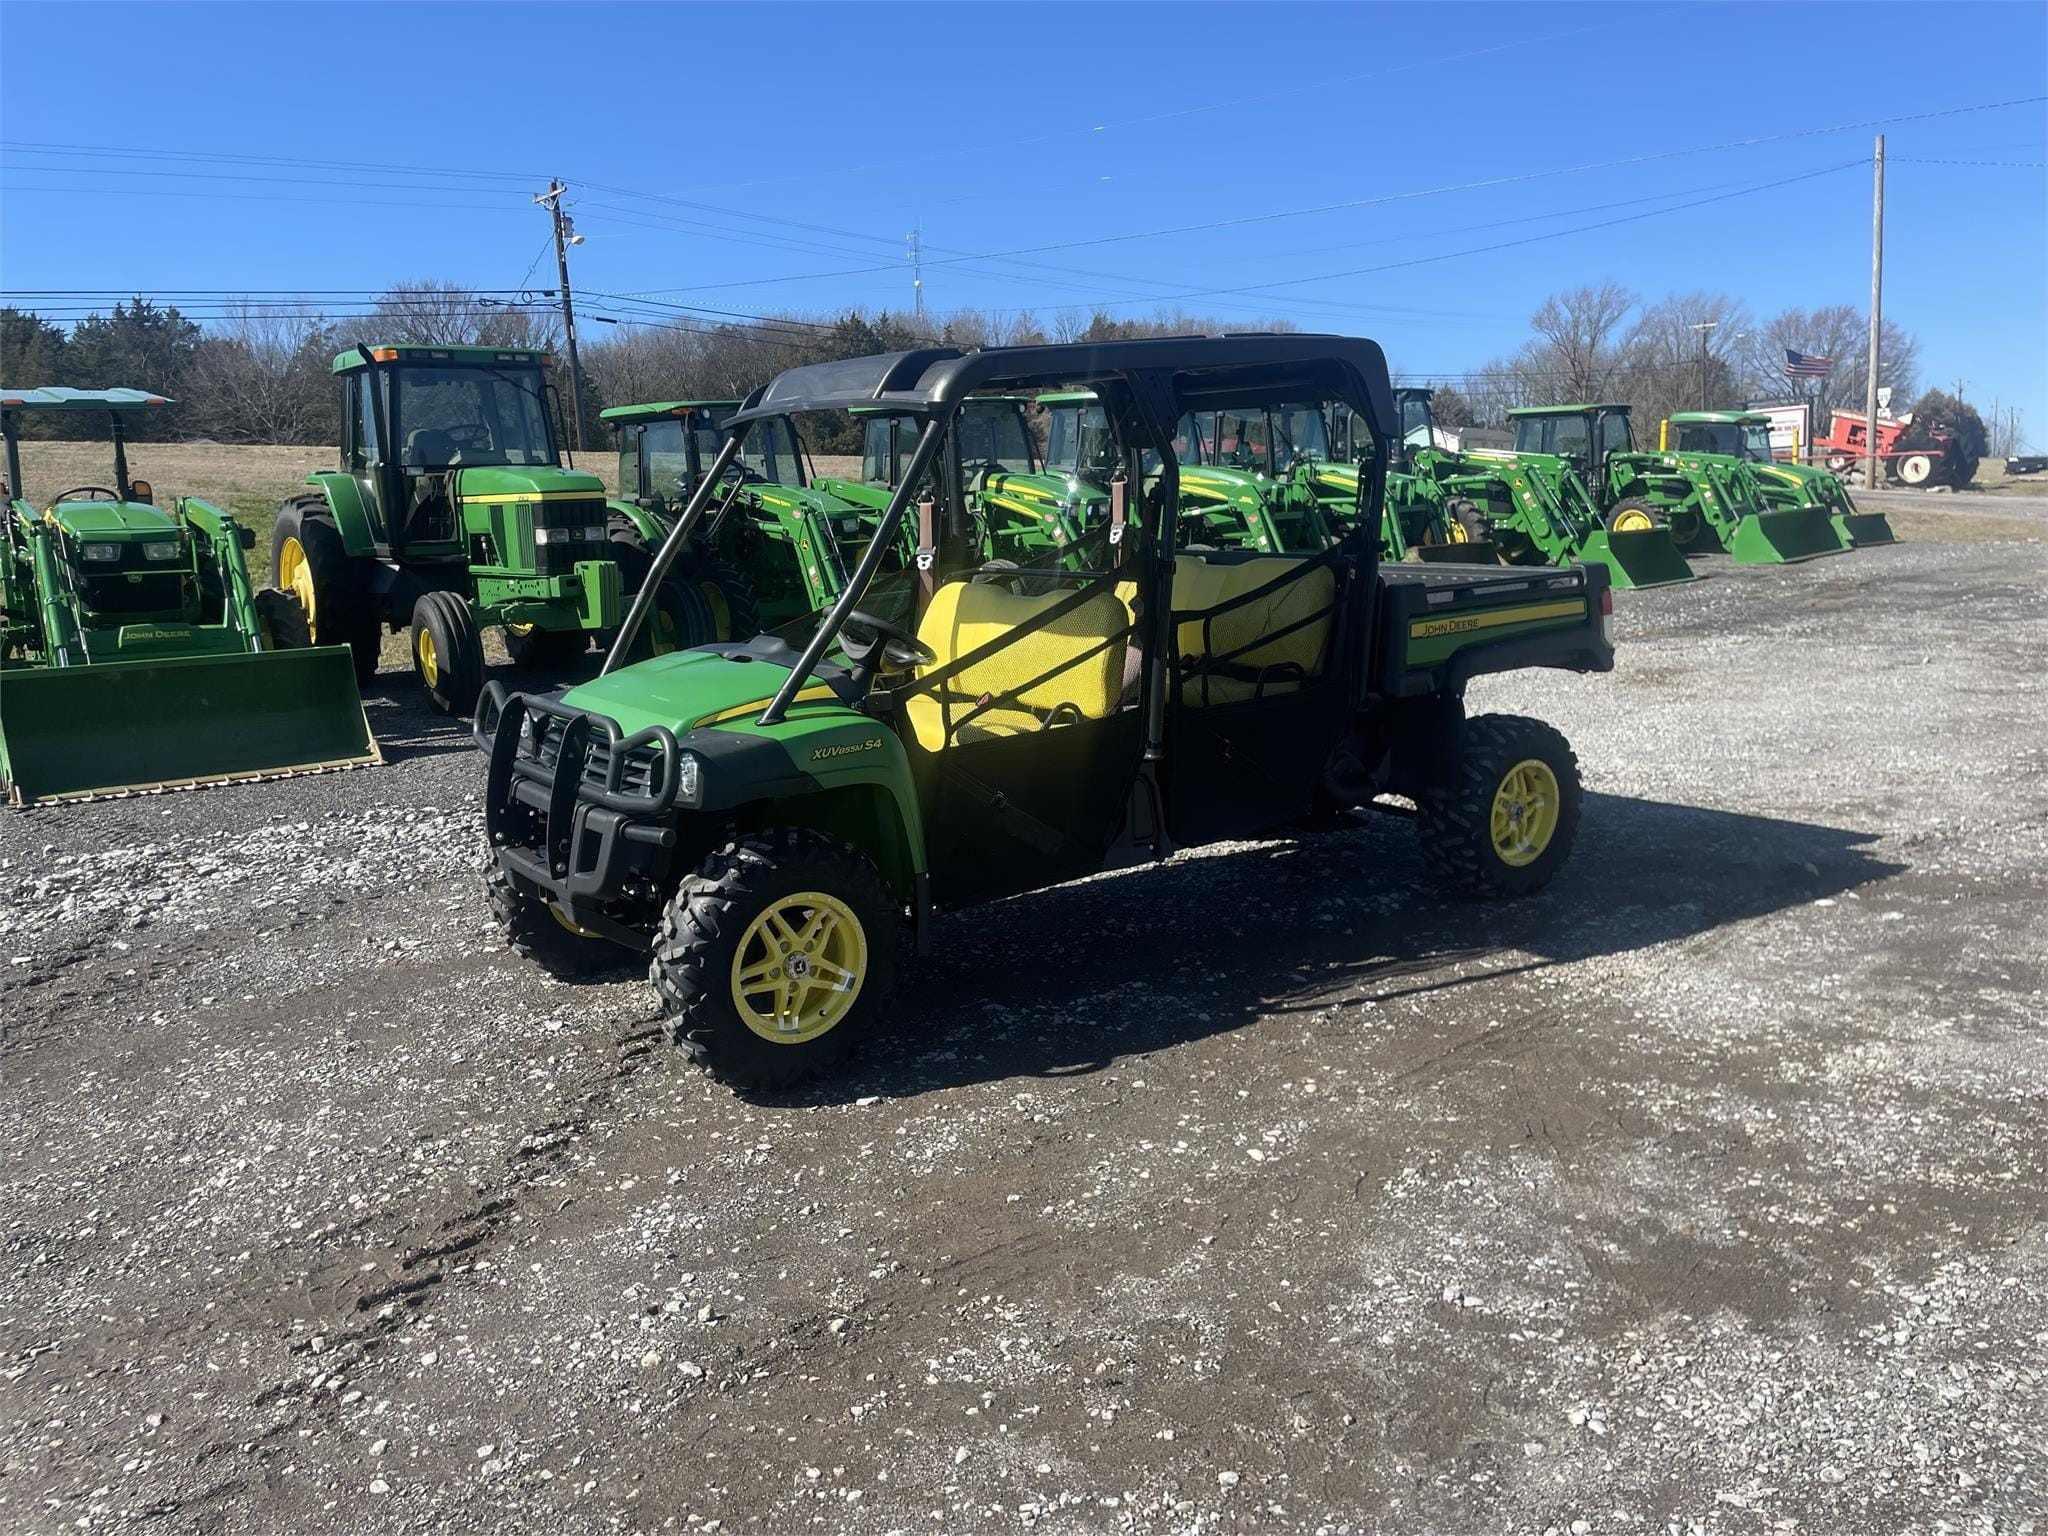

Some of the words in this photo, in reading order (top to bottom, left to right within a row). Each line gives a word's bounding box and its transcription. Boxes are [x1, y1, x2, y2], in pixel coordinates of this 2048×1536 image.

[124, 630, 153, 640] JOHN
[155, 630, 191, 638] DEERE
[1423, 624, 1448, 635] JOHN
[1449, 618, 1479, 631] DEERE
[812, 744, 864, 760] XUV855M
[864, 738, 882, 750] S4
